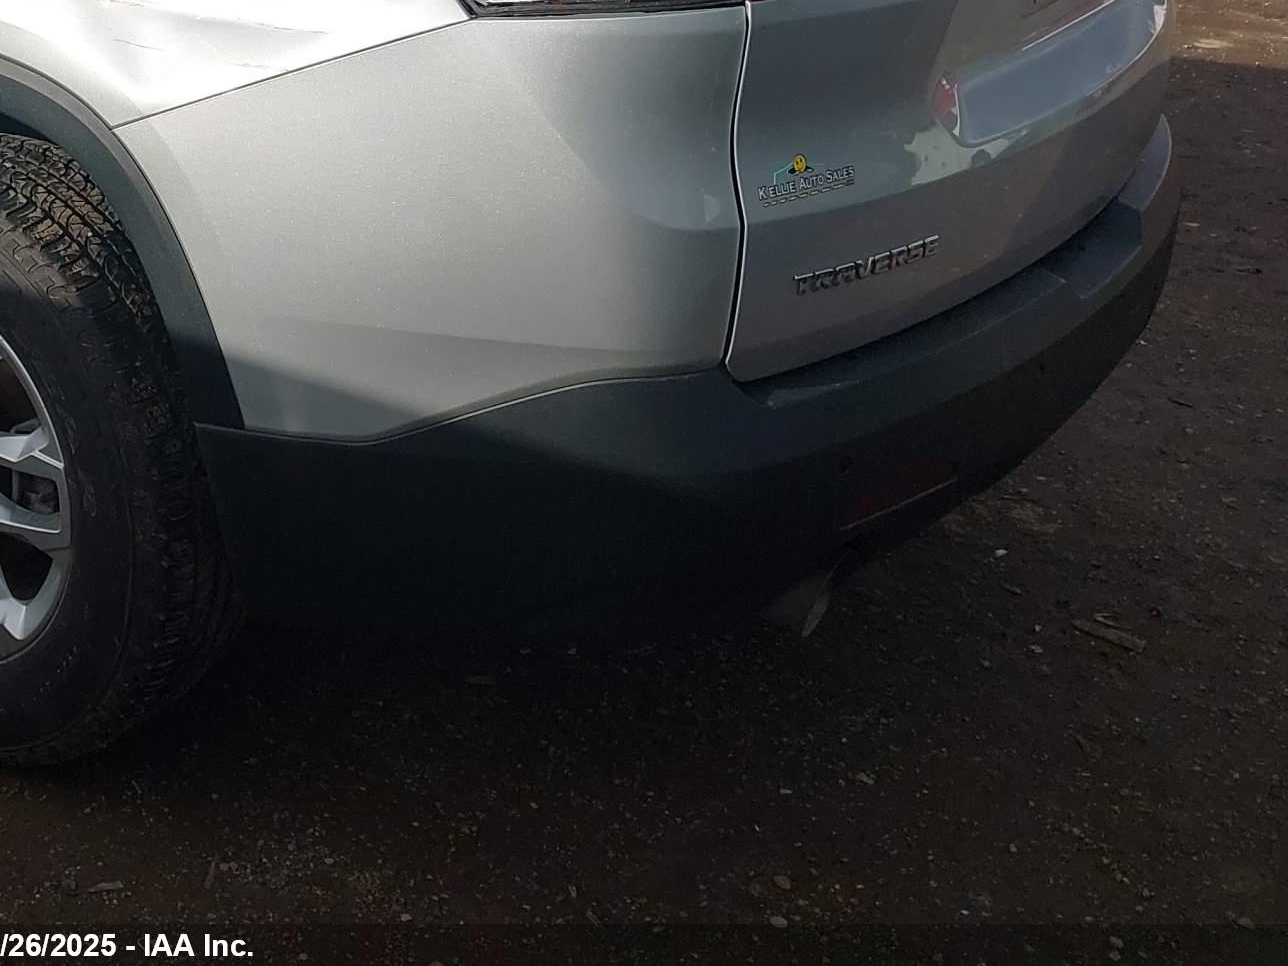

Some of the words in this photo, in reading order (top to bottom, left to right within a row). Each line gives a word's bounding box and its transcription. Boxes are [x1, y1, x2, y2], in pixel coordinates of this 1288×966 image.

[799, 173, 825, 191] AUTO
[826, 165, 856, 183] SALES
[794, 234, 940, 296] TRAVERSE
